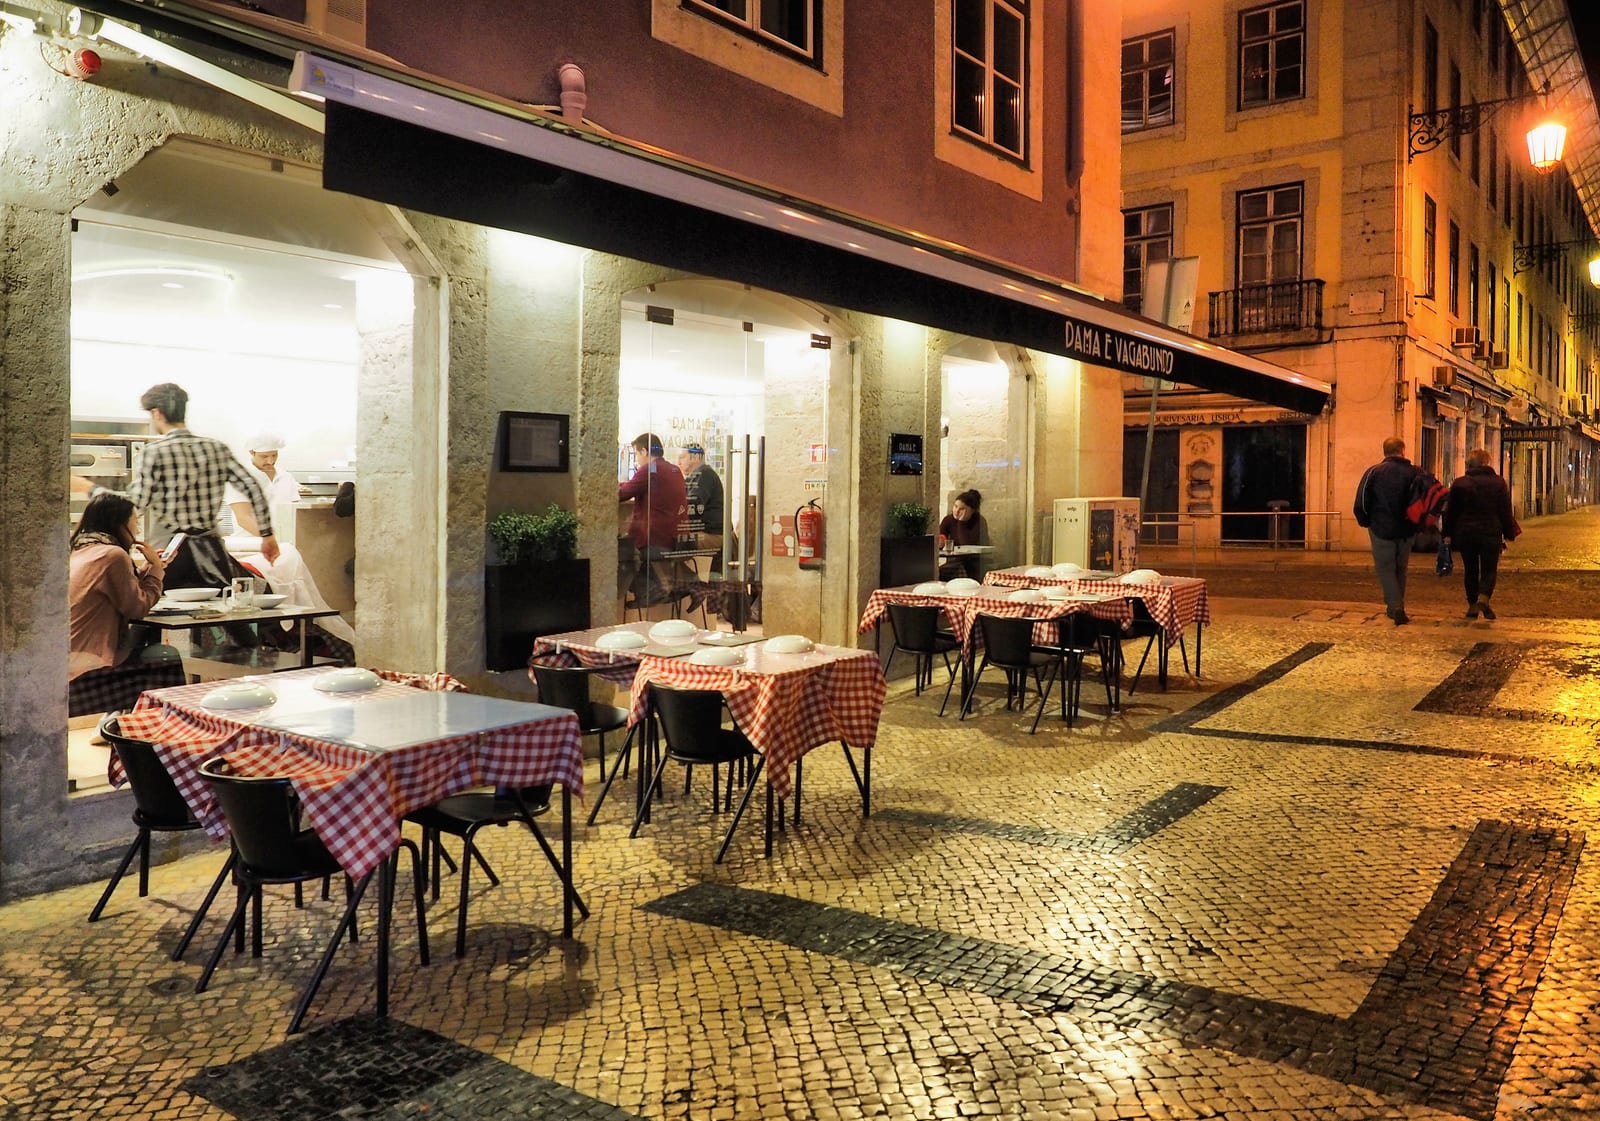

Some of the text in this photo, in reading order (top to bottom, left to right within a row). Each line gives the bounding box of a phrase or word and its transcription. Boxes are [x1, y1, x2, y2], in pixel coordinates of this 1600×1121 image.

[1065, 320, 1174, 375] DAMA E VAGABUNDO
[1211, 412, 1240, 420] LISBOA
